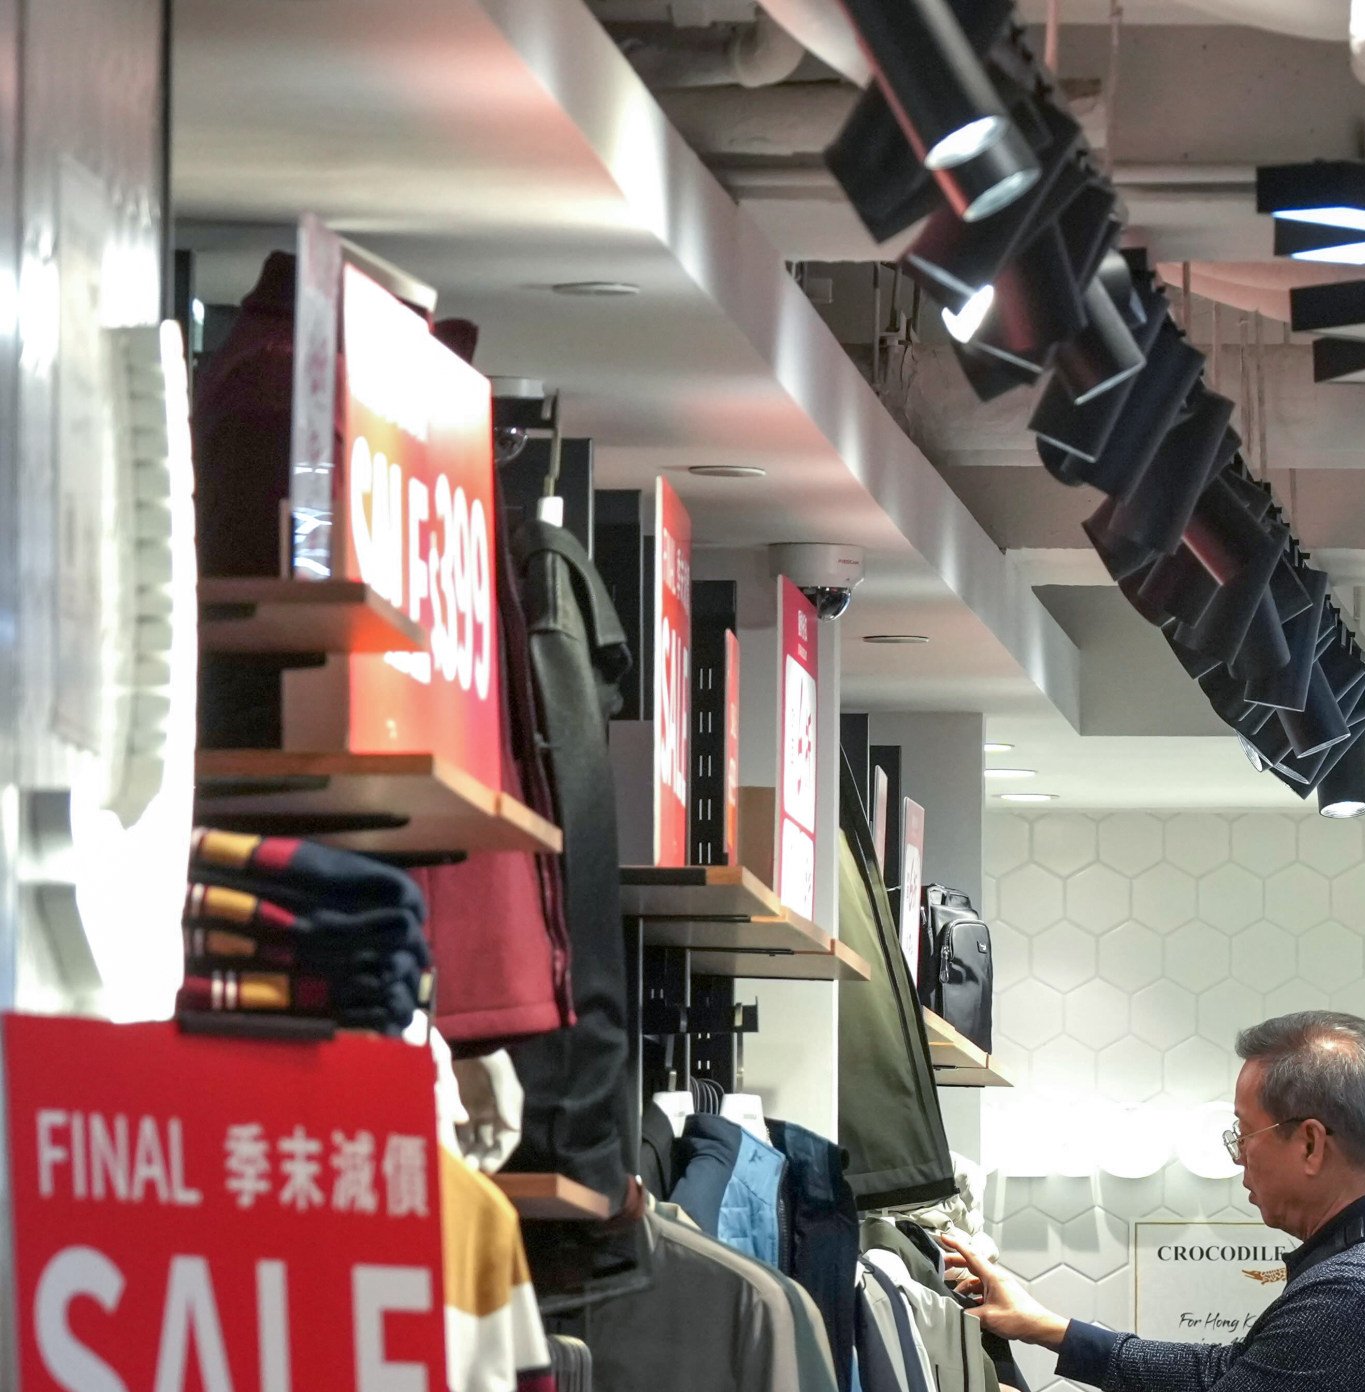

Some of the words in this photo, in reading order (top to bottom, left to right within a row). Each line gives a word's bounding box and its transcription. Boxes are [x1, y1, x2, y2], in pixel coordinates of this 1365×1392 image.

[36, 1108, 203, 1206] FINAL
[225, 1123, 428, 1217] 季末減價
[1157, 1245, 1286, 1262] CROCODILE
[1178, 1312, 1203, 1328] For
[1204, 1312, 1239, 1333] Hong
